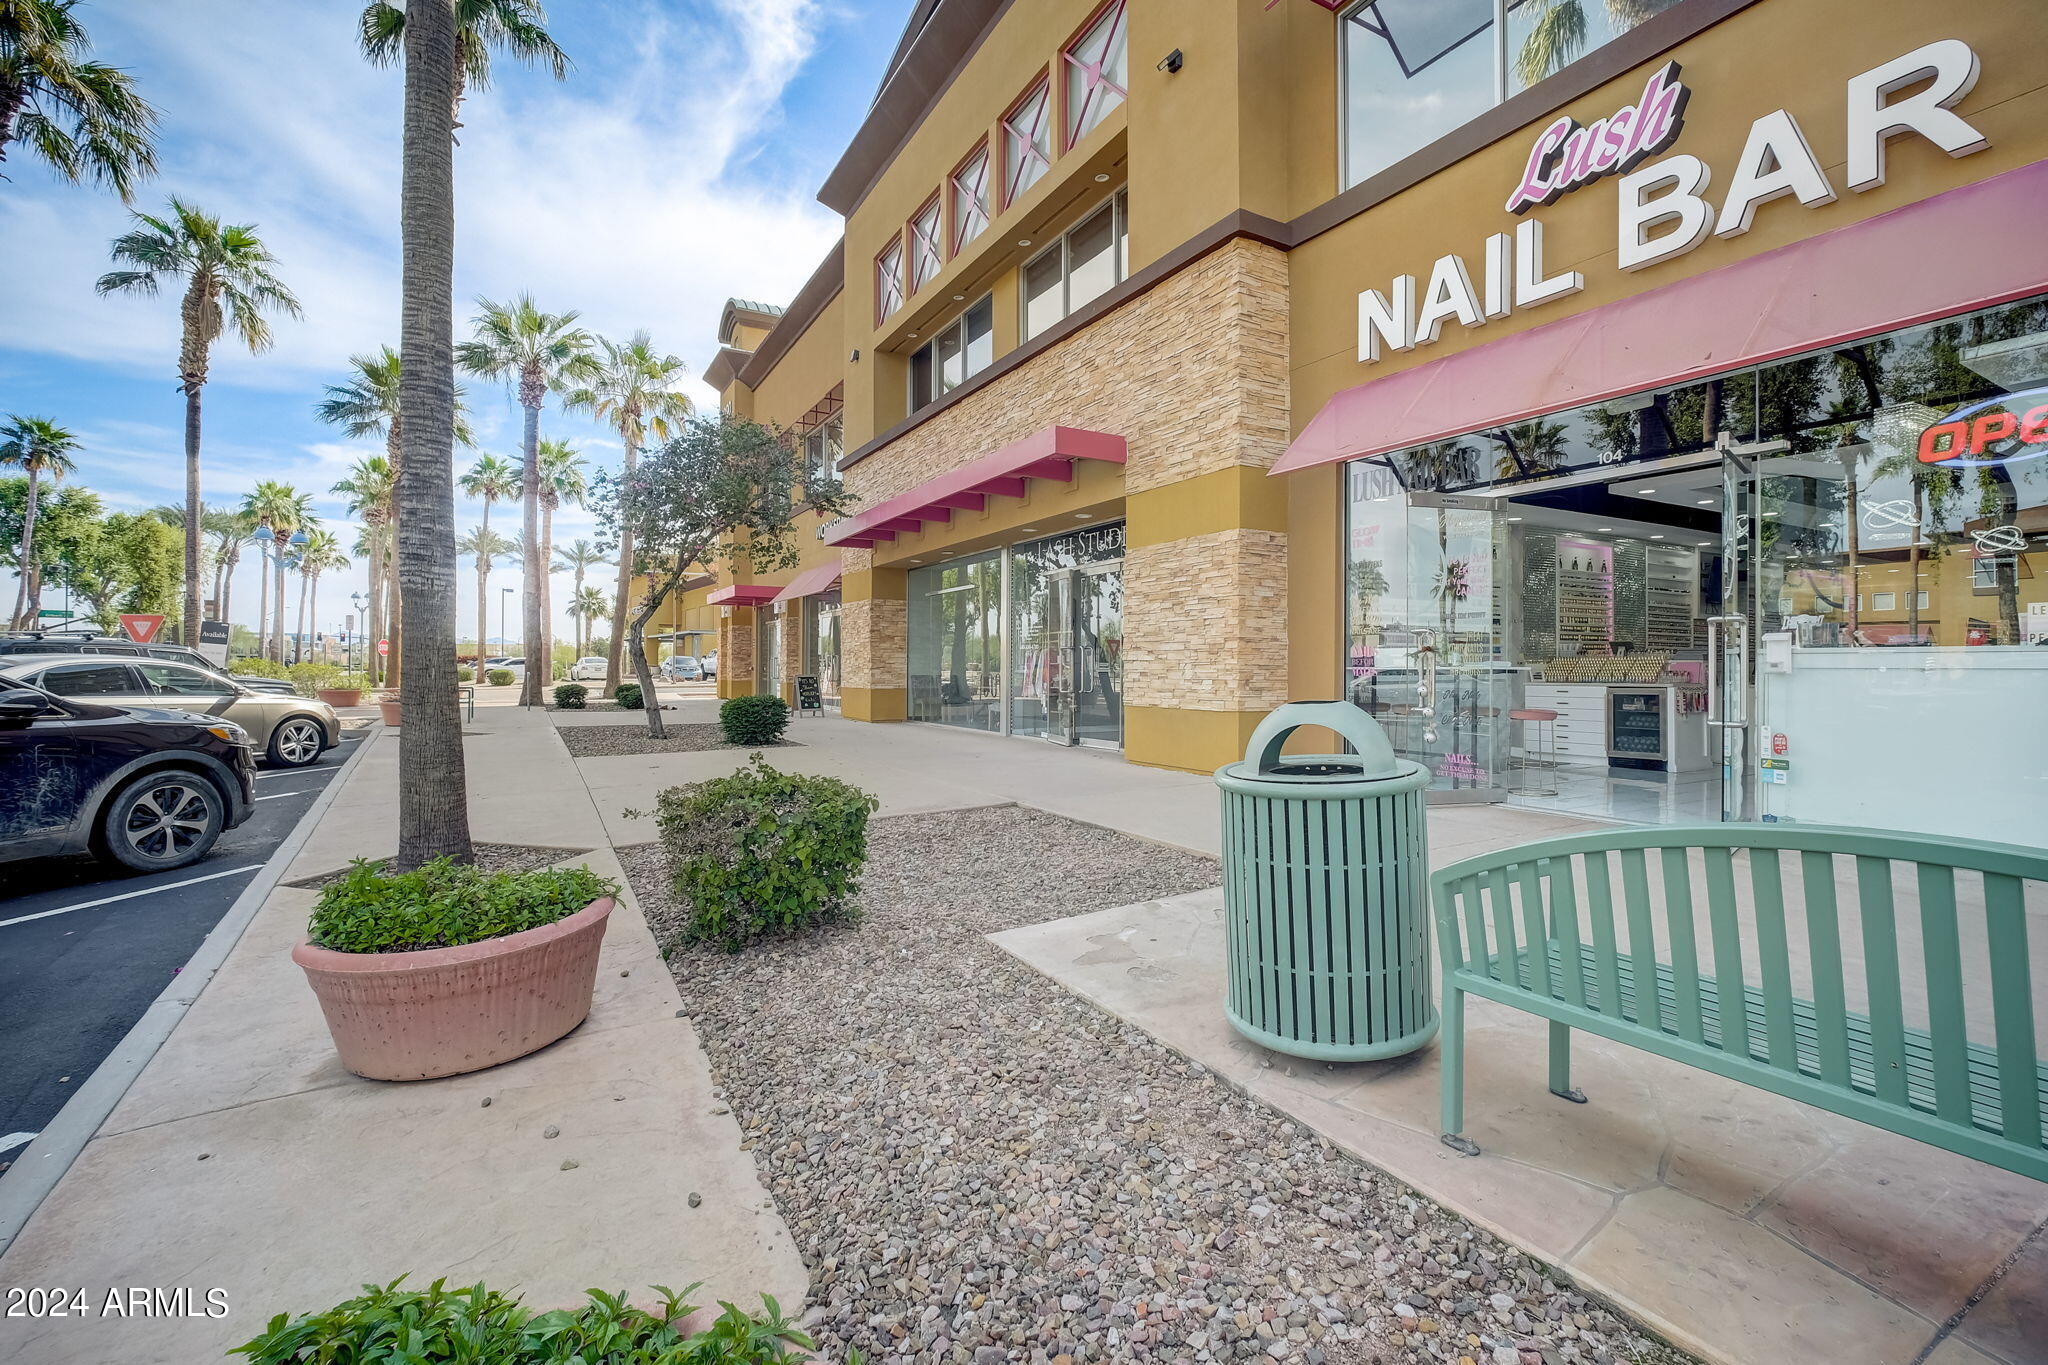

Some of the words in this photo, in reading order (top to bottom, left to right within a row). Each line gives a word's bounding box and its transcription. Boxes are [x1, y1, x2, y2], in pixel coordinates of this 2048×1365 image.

[1505, 60, 1690, 215] Lush
[1358, 219, 1584, 364] NAIL
[1618, 39, 1992, 272] BAR
[1352, 467, 1395, 503] LUSH
[1440, 447, 1482, 490] BAR
[1597, 449, 1623, 464] 104
[201, 631, 228, 639] Available
